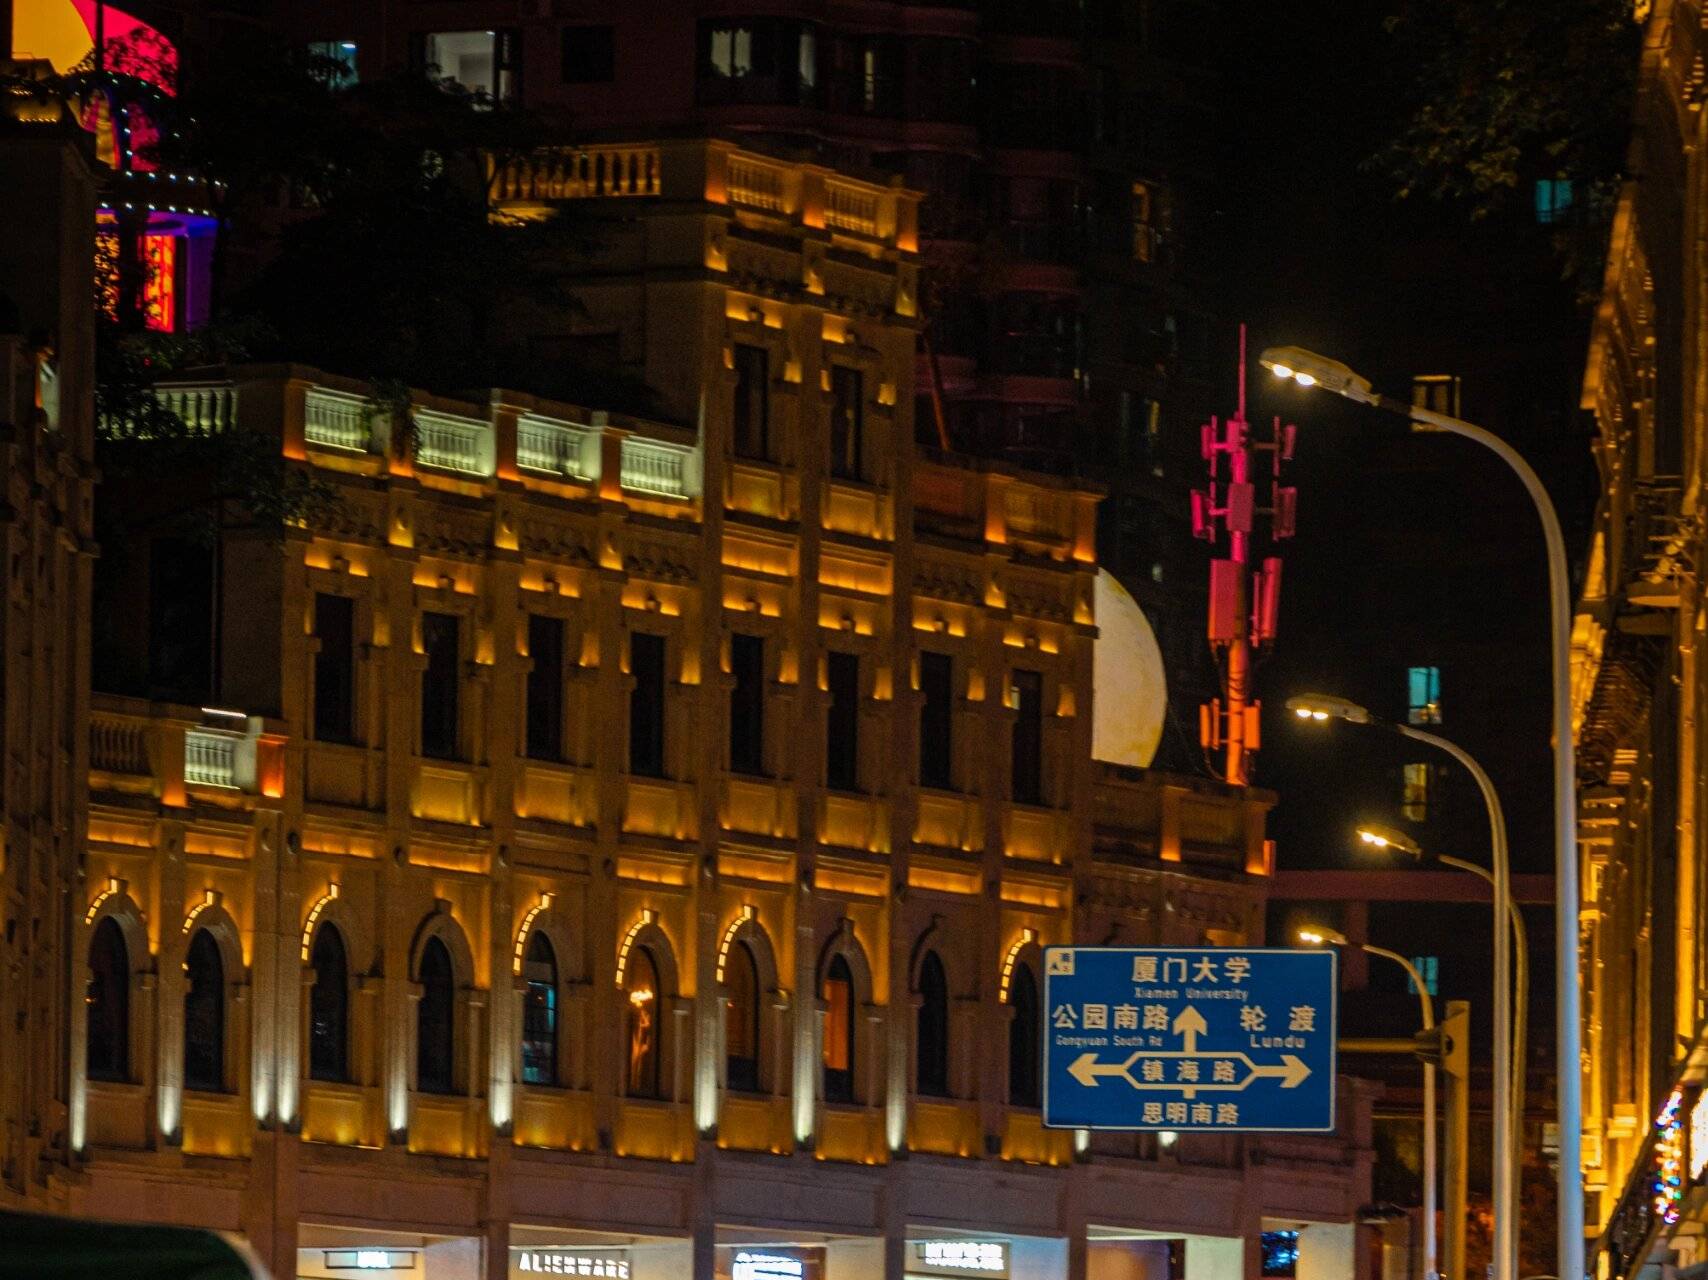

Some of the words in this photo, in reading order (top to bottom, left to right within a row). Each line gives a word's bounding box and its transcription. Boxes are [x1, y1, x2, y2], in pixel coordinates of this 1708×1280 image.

[1132, 956, 1251, 983] 厦门大学
[1135, 987, 1179, 999] Xiamen
[1186, 988, 1248, 1001] University
[1051, 1003, 1169, 1030] 公园南路
[1240, 1005, 1316, 1031] 轮渡
[1250, 1034, 1305, 1048] Lundu
[1142, 1060, 1235, 1082] 镇海路
[1142, 1102, 1239, 1124] 思明南路
